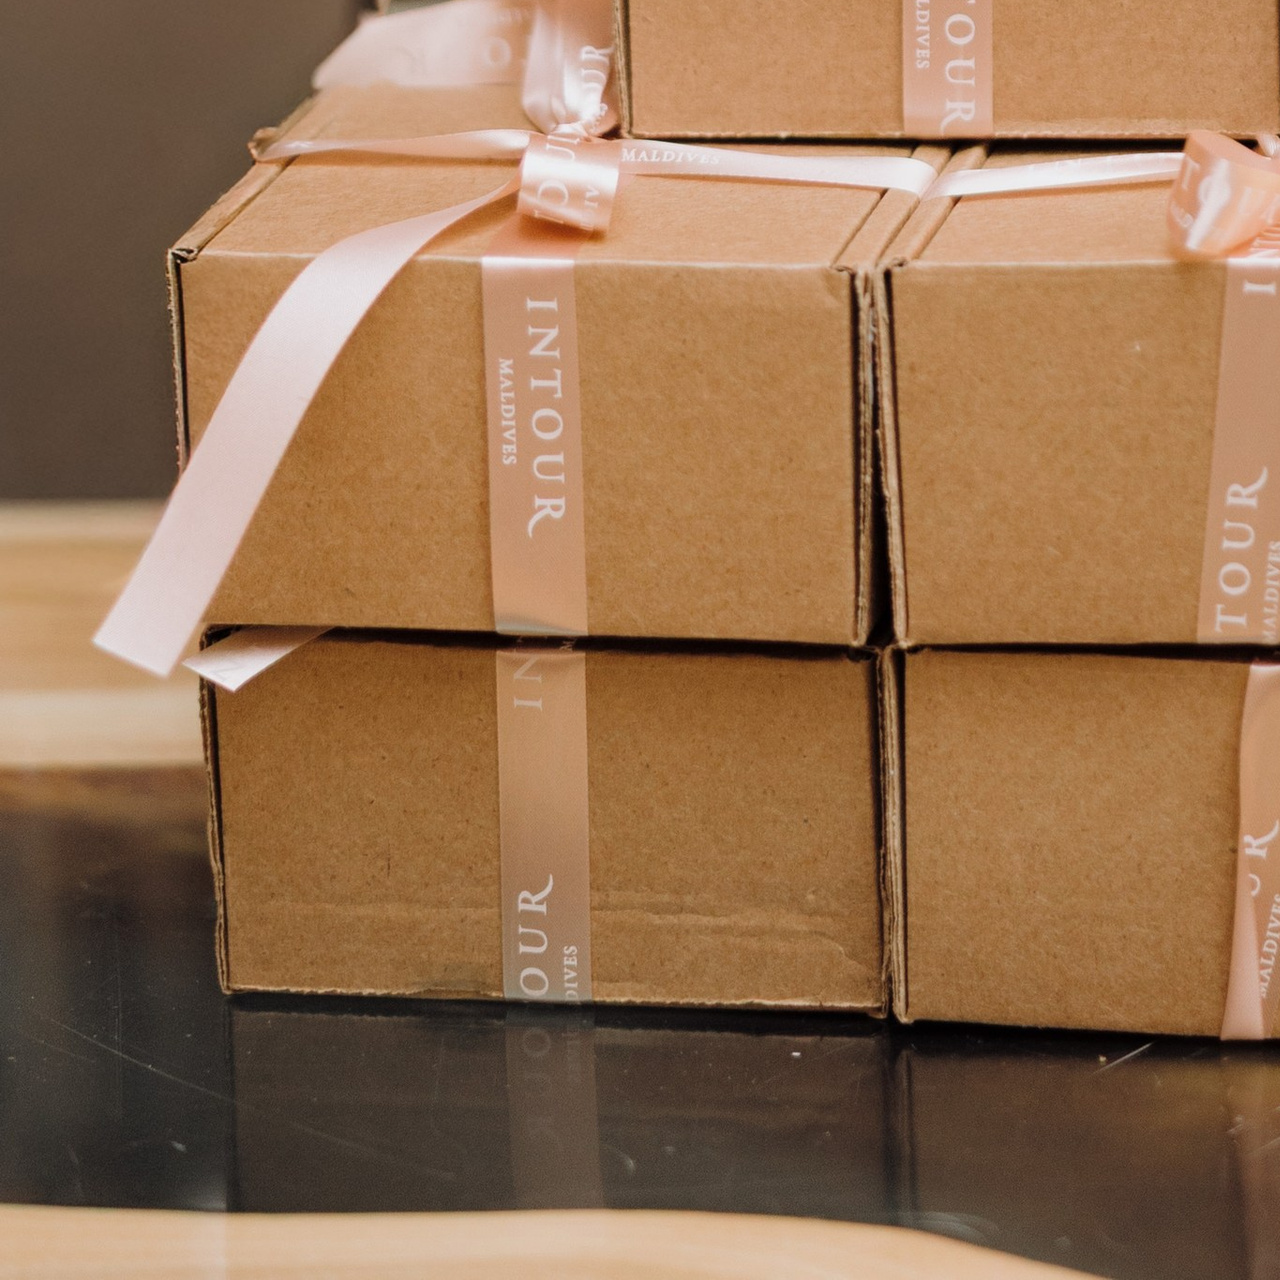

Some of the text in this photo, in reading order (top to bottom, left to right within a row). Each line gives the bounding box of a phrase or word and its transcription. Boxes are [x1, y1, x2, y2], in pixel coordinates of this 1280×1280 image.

[621, 147, 721, 165] MALDIVES
[499, 357, 517, 466] MALDIVES
[526, 297, 566, 539] INTOUR
